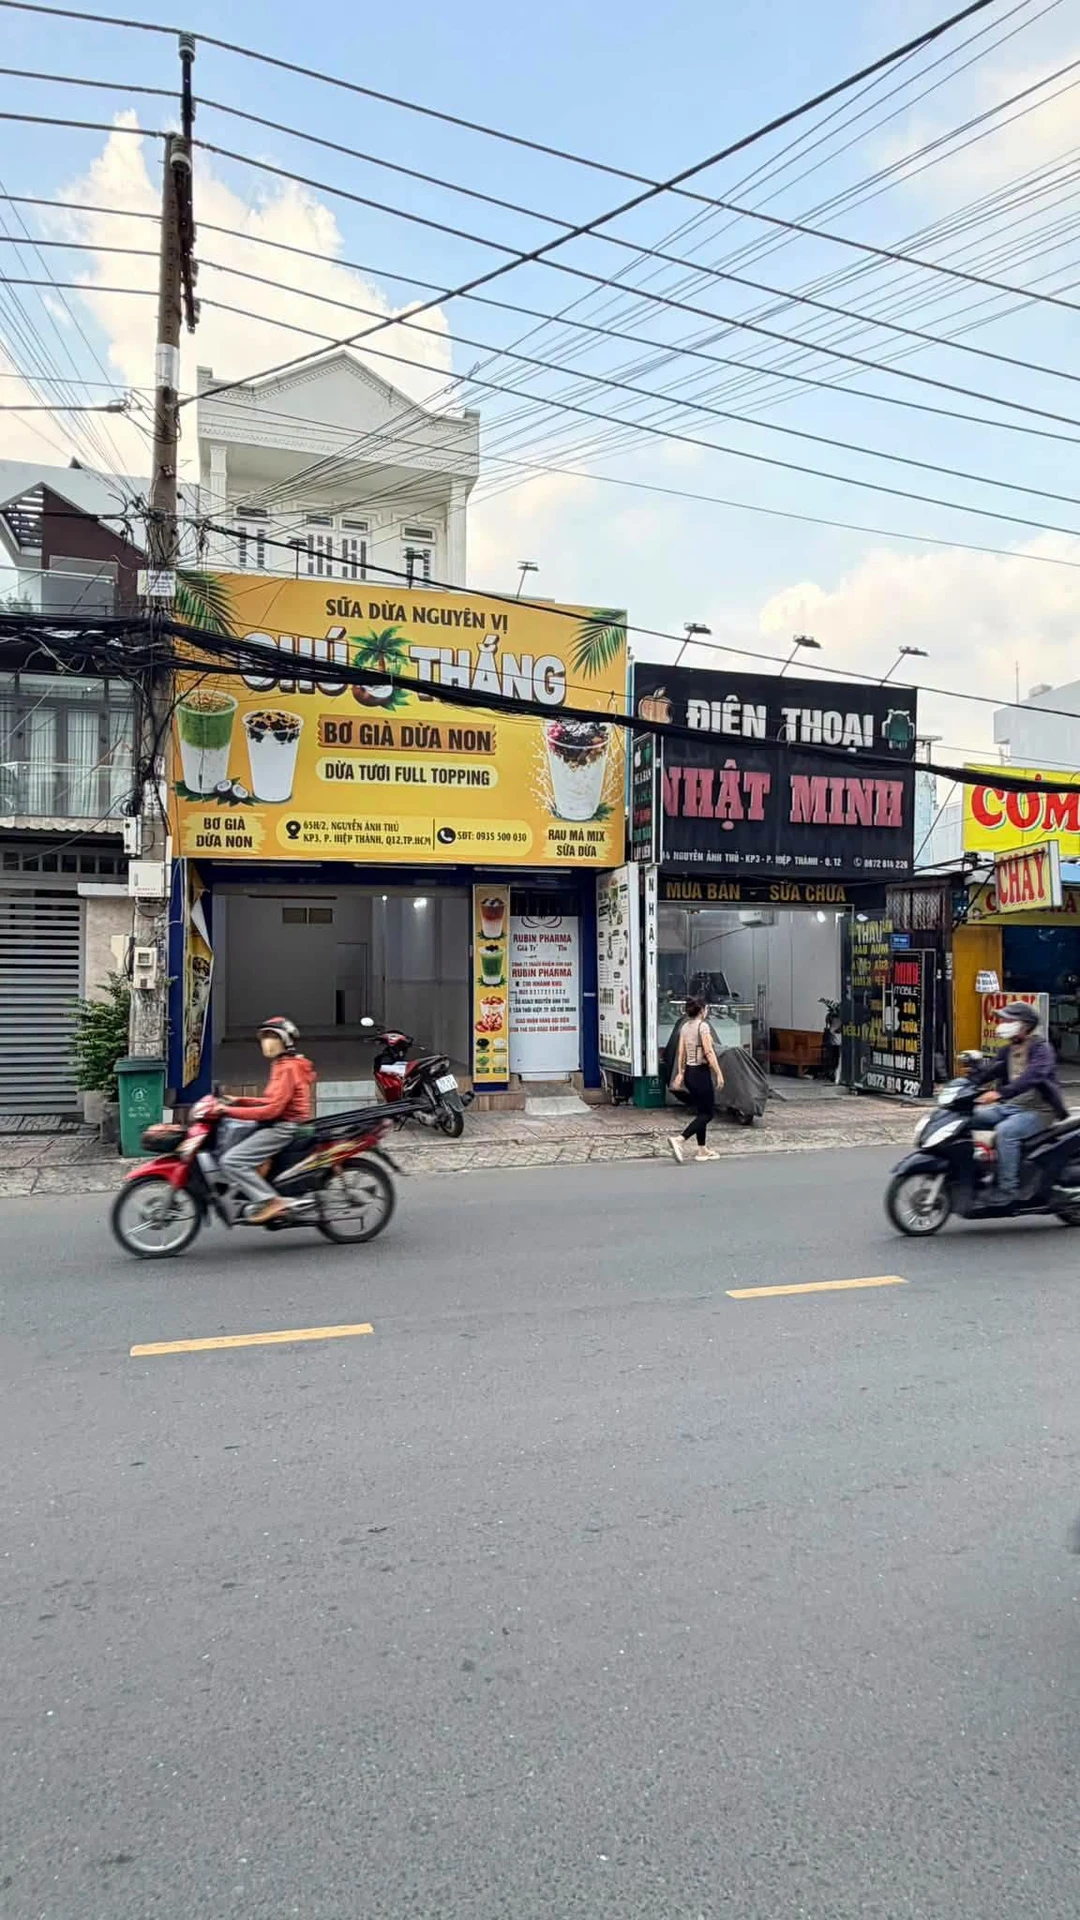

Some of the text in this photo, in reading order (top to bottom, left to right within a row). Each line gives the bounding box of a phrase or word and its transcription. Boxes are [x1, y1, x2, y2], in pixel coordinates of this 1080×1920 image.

[326, 596, 508, 636] SỮA DỪA NGUYÊN VỊ
[408, 634, 567, 707] THẮNG
[324, 720, 491, 751] BƠ GIÀ DỪA NON
[782, 707, 874, 753] THOẠI
[325, 760, 490, 786] DỪA TƯƠI FULL TOPPING
[663, 759, 904, 831] NHẬT MINH
[204, 815, 245, 830] BƠ GIÀ
[226, 835, 253, 848] NON
[497, 831, 511, 842] 500
[548, 829, 567, 841] RAU
[587, 830, 605, 842] MIX
[833, 857, 841, 867] 12
[997, 847, 1046, 905] CHAY
[666, 882, 703, 900] MUA
[513, 933, 572, 943] RUBIN PHARMA
[512, 968, 572, 978] RUBIN PHARMA
